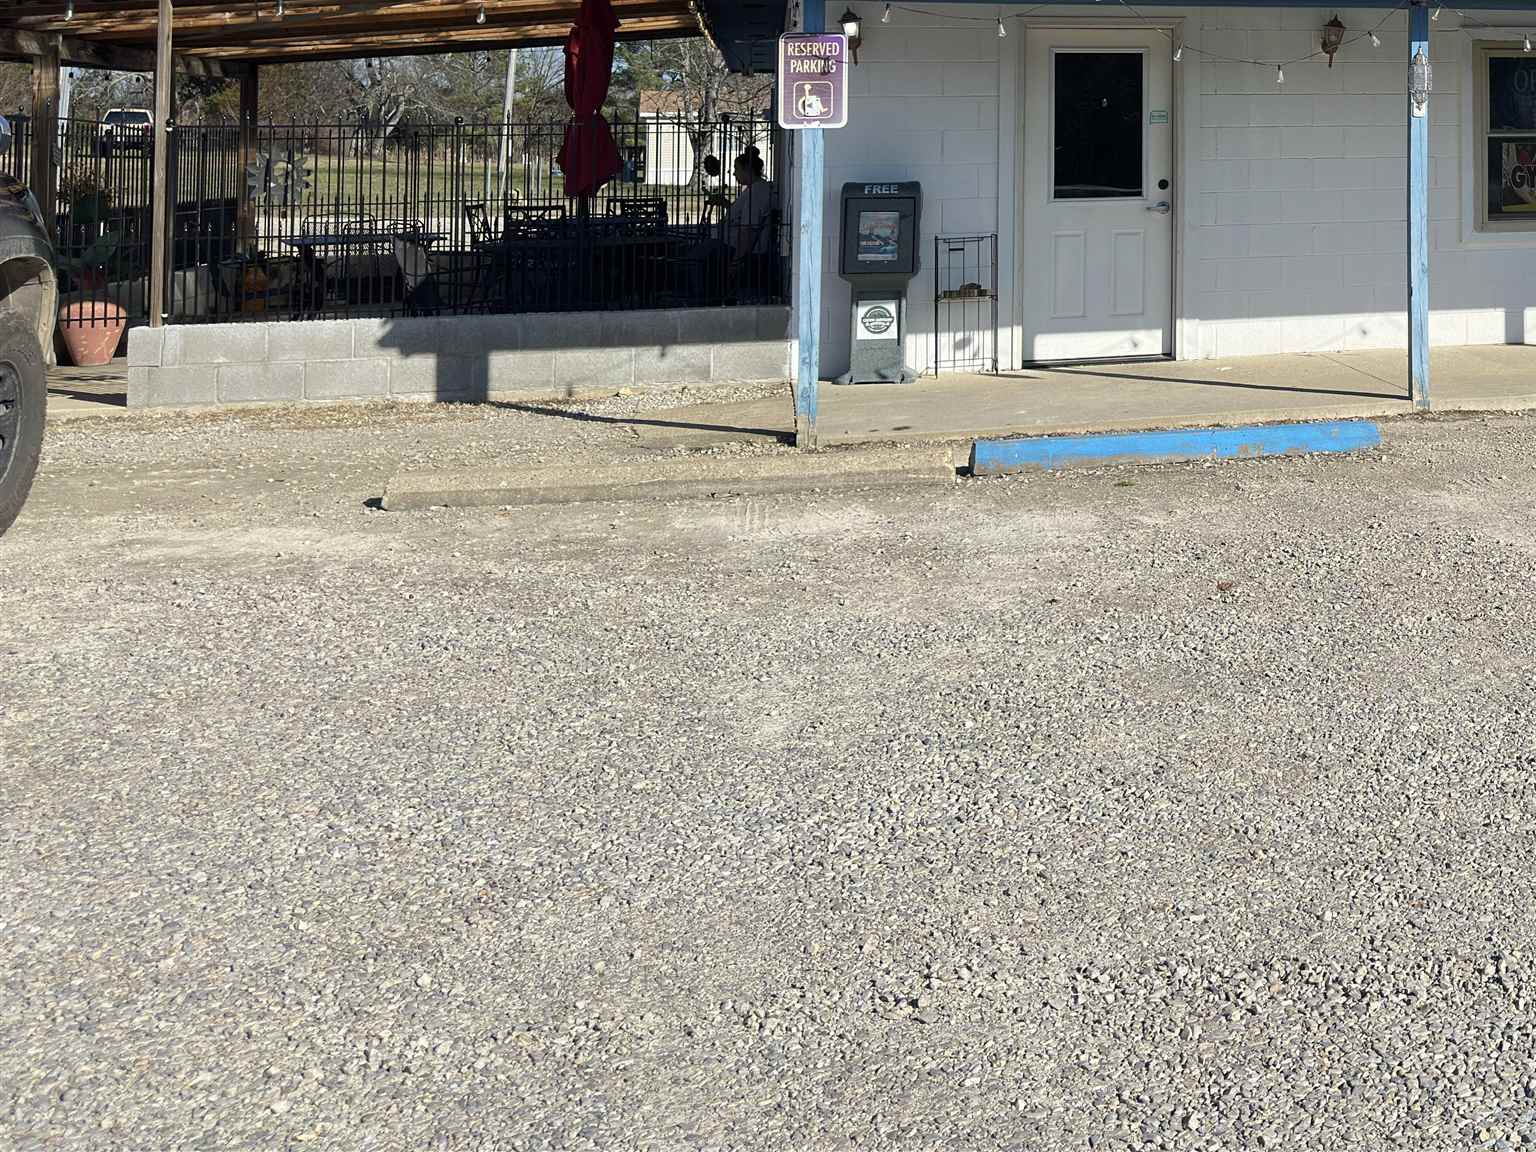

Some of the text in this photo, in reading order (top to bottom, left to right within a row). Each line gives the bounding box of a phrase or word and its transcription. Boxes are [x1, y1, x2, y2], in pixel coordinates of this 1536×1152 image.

[788, 42, 840, 57] RESERVED
[791, 59, 837, 73] PARKING
[864, 184, 899, 194] FREE
